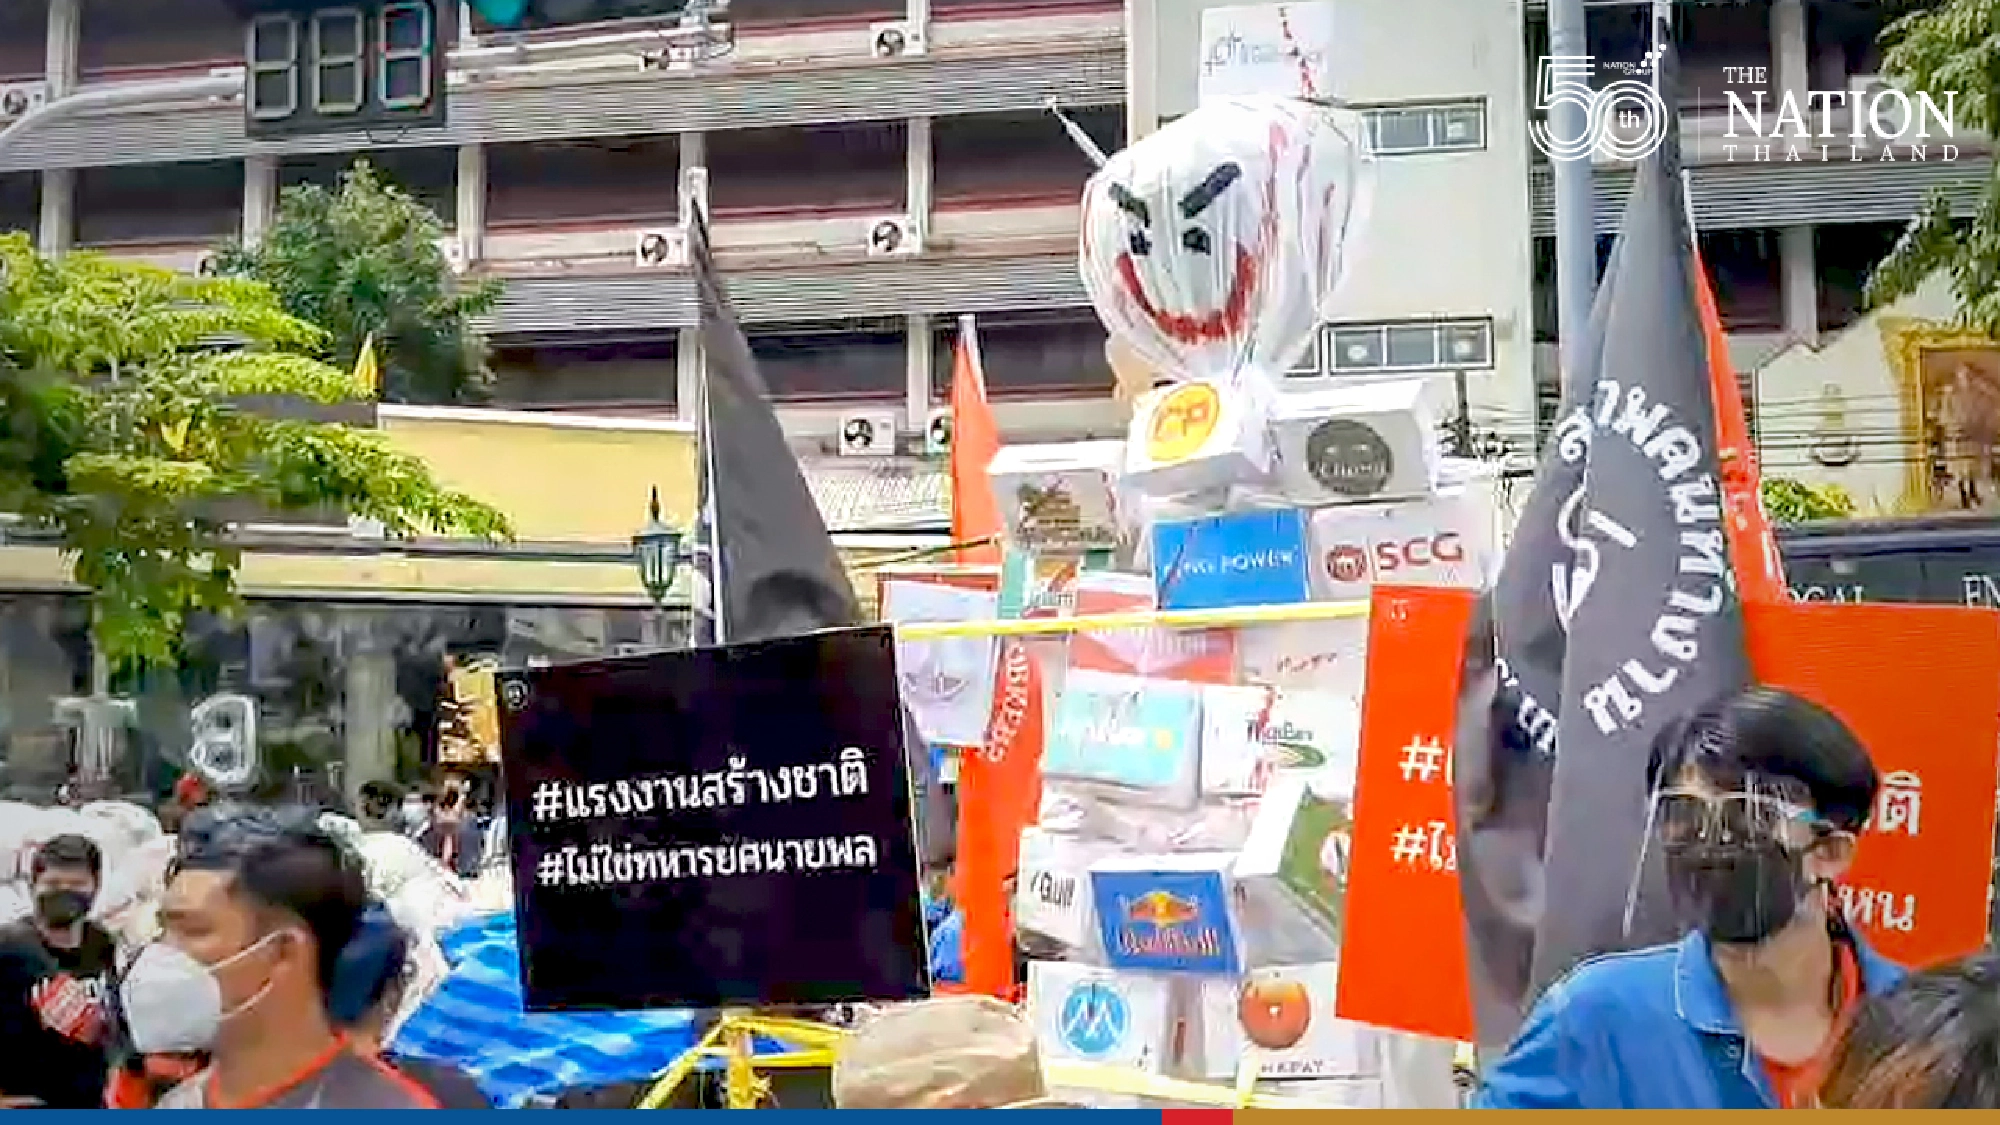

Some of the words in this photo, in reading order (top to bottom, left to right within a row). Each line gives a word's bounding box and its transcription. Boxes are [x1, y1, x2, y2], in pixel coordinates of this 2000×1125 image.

[1375, 532, 1463, 571] SCG
[532, 747, 869, 821] #แรงงานสร้างชาติ
